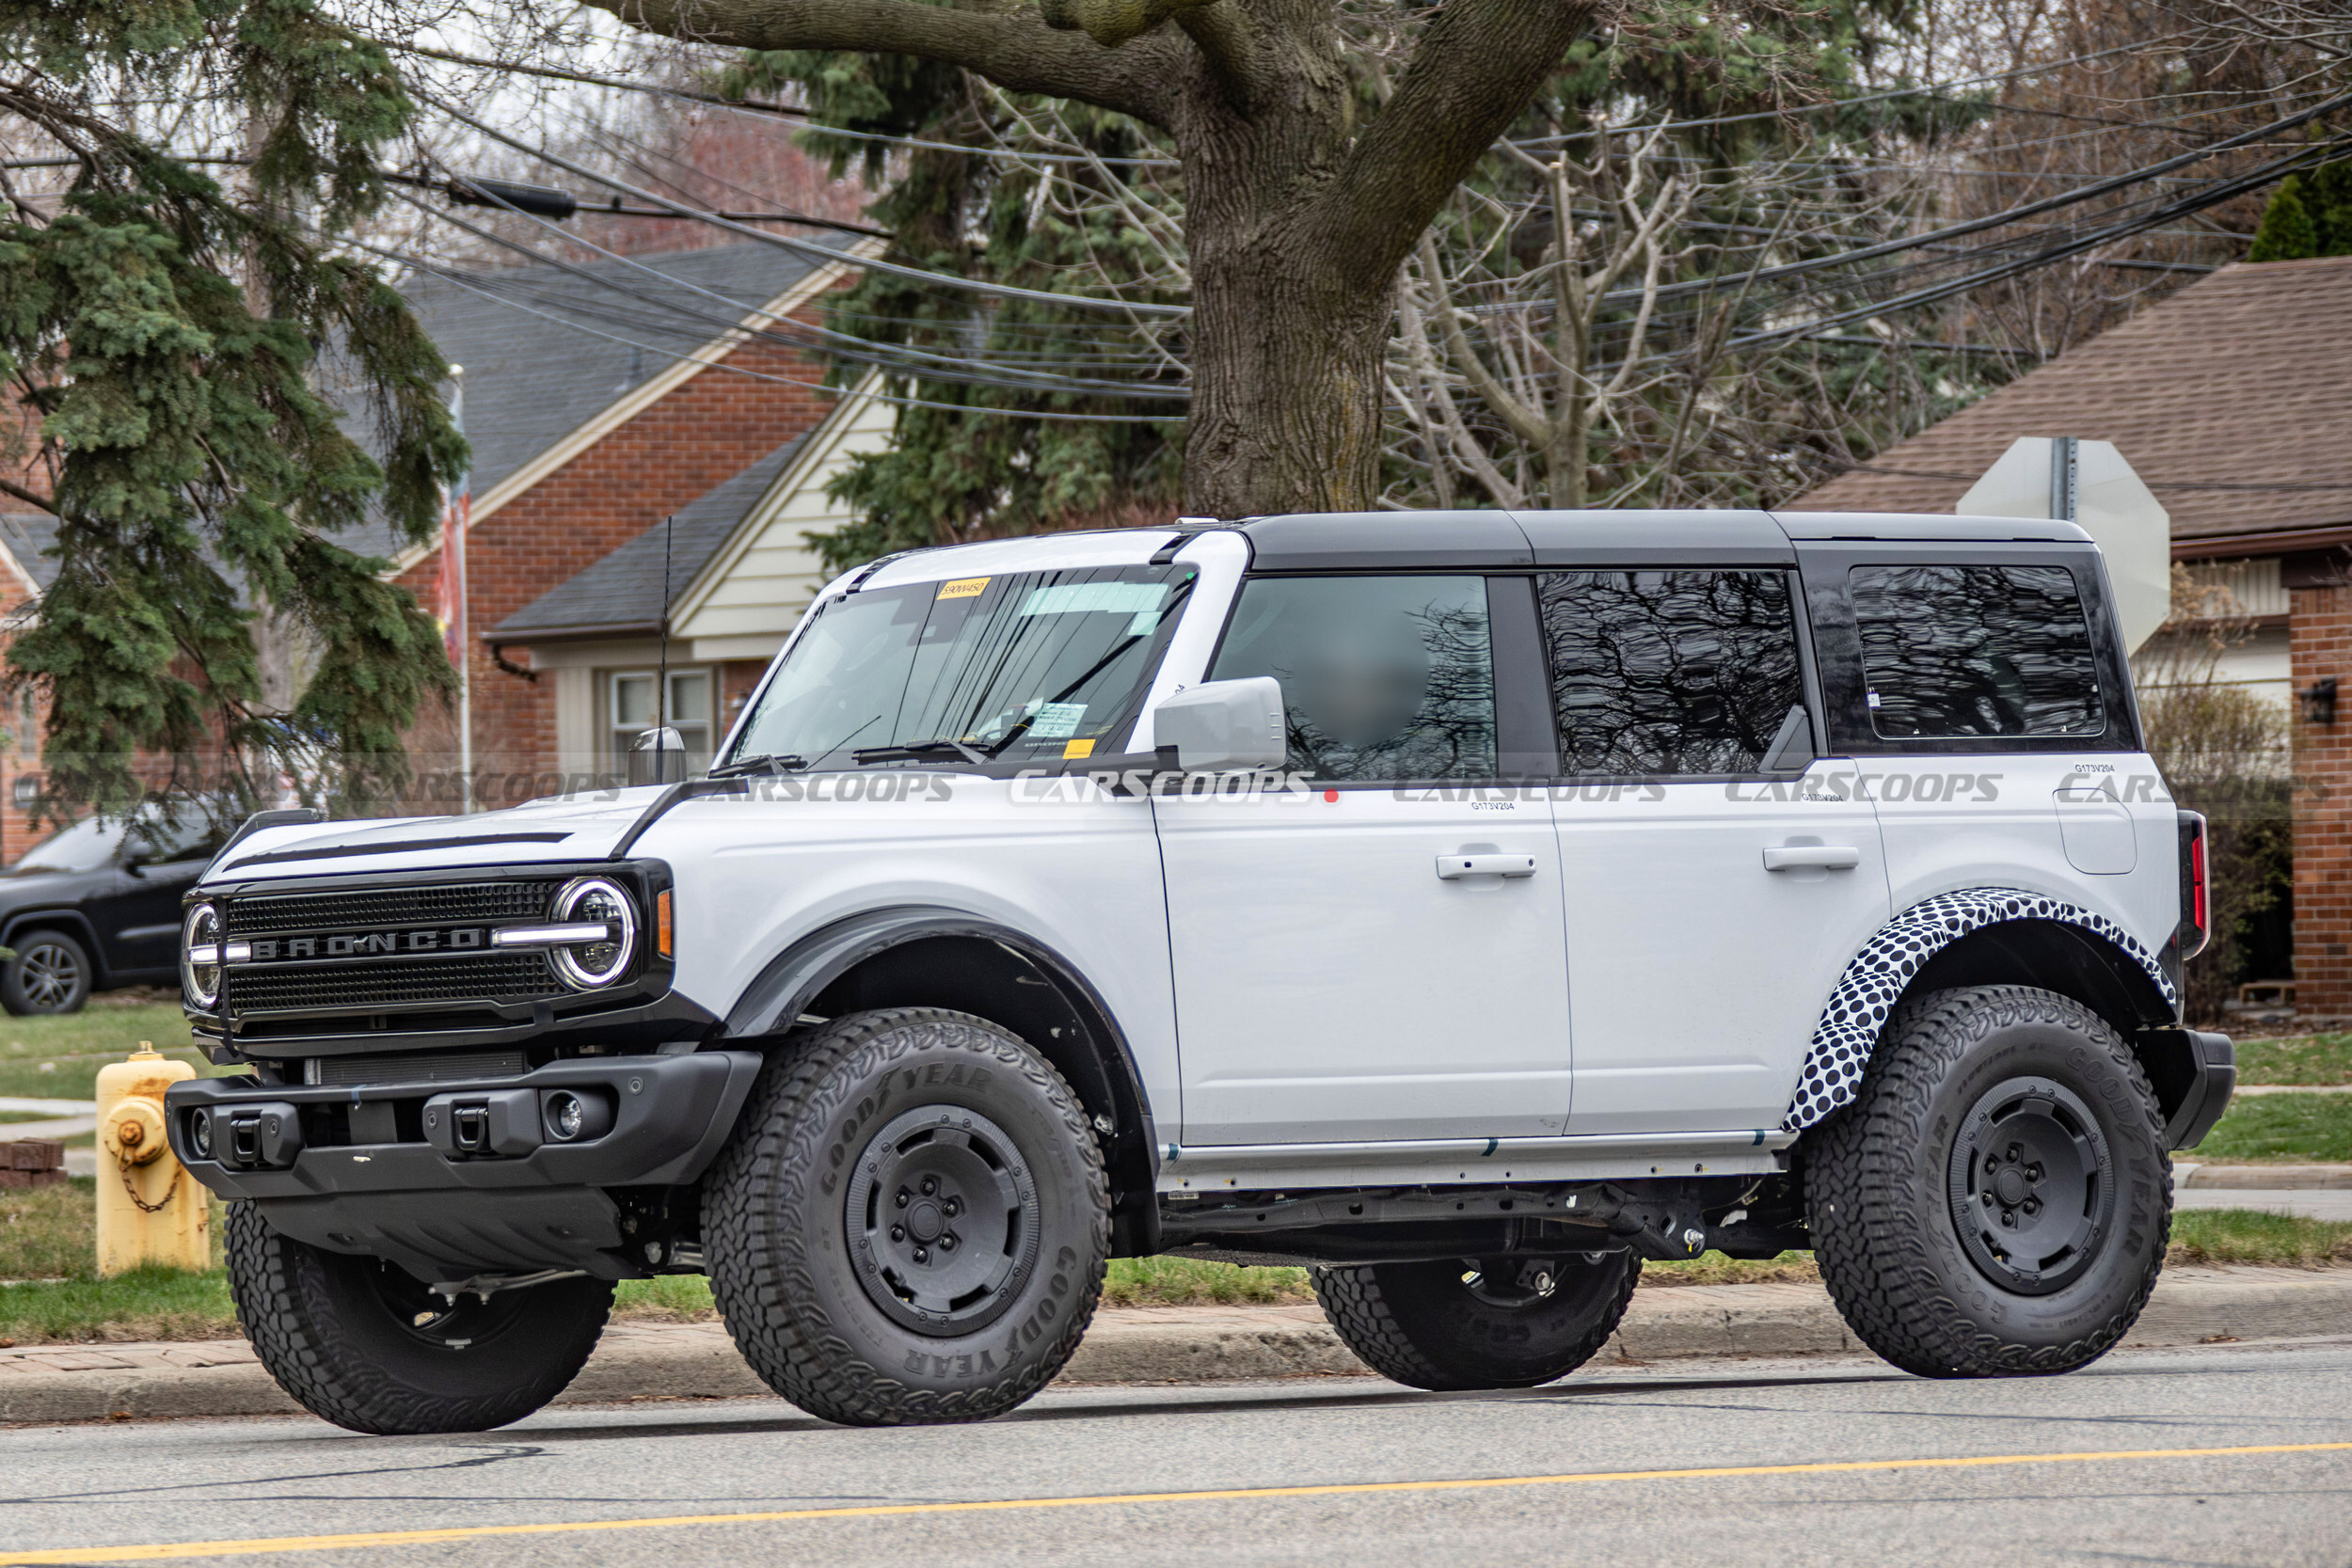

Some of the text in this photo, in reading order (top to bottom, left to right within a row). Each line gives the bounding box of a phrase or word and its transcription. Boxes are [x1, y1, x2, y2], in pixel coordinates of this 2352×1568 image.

[2074, 764, 2115, 773] G173V204
[1802, 793, 1844, 802] G173V204
[1470, 801, 1515, 810] G173V204
[252, 927, 483, 960] BRONCO
